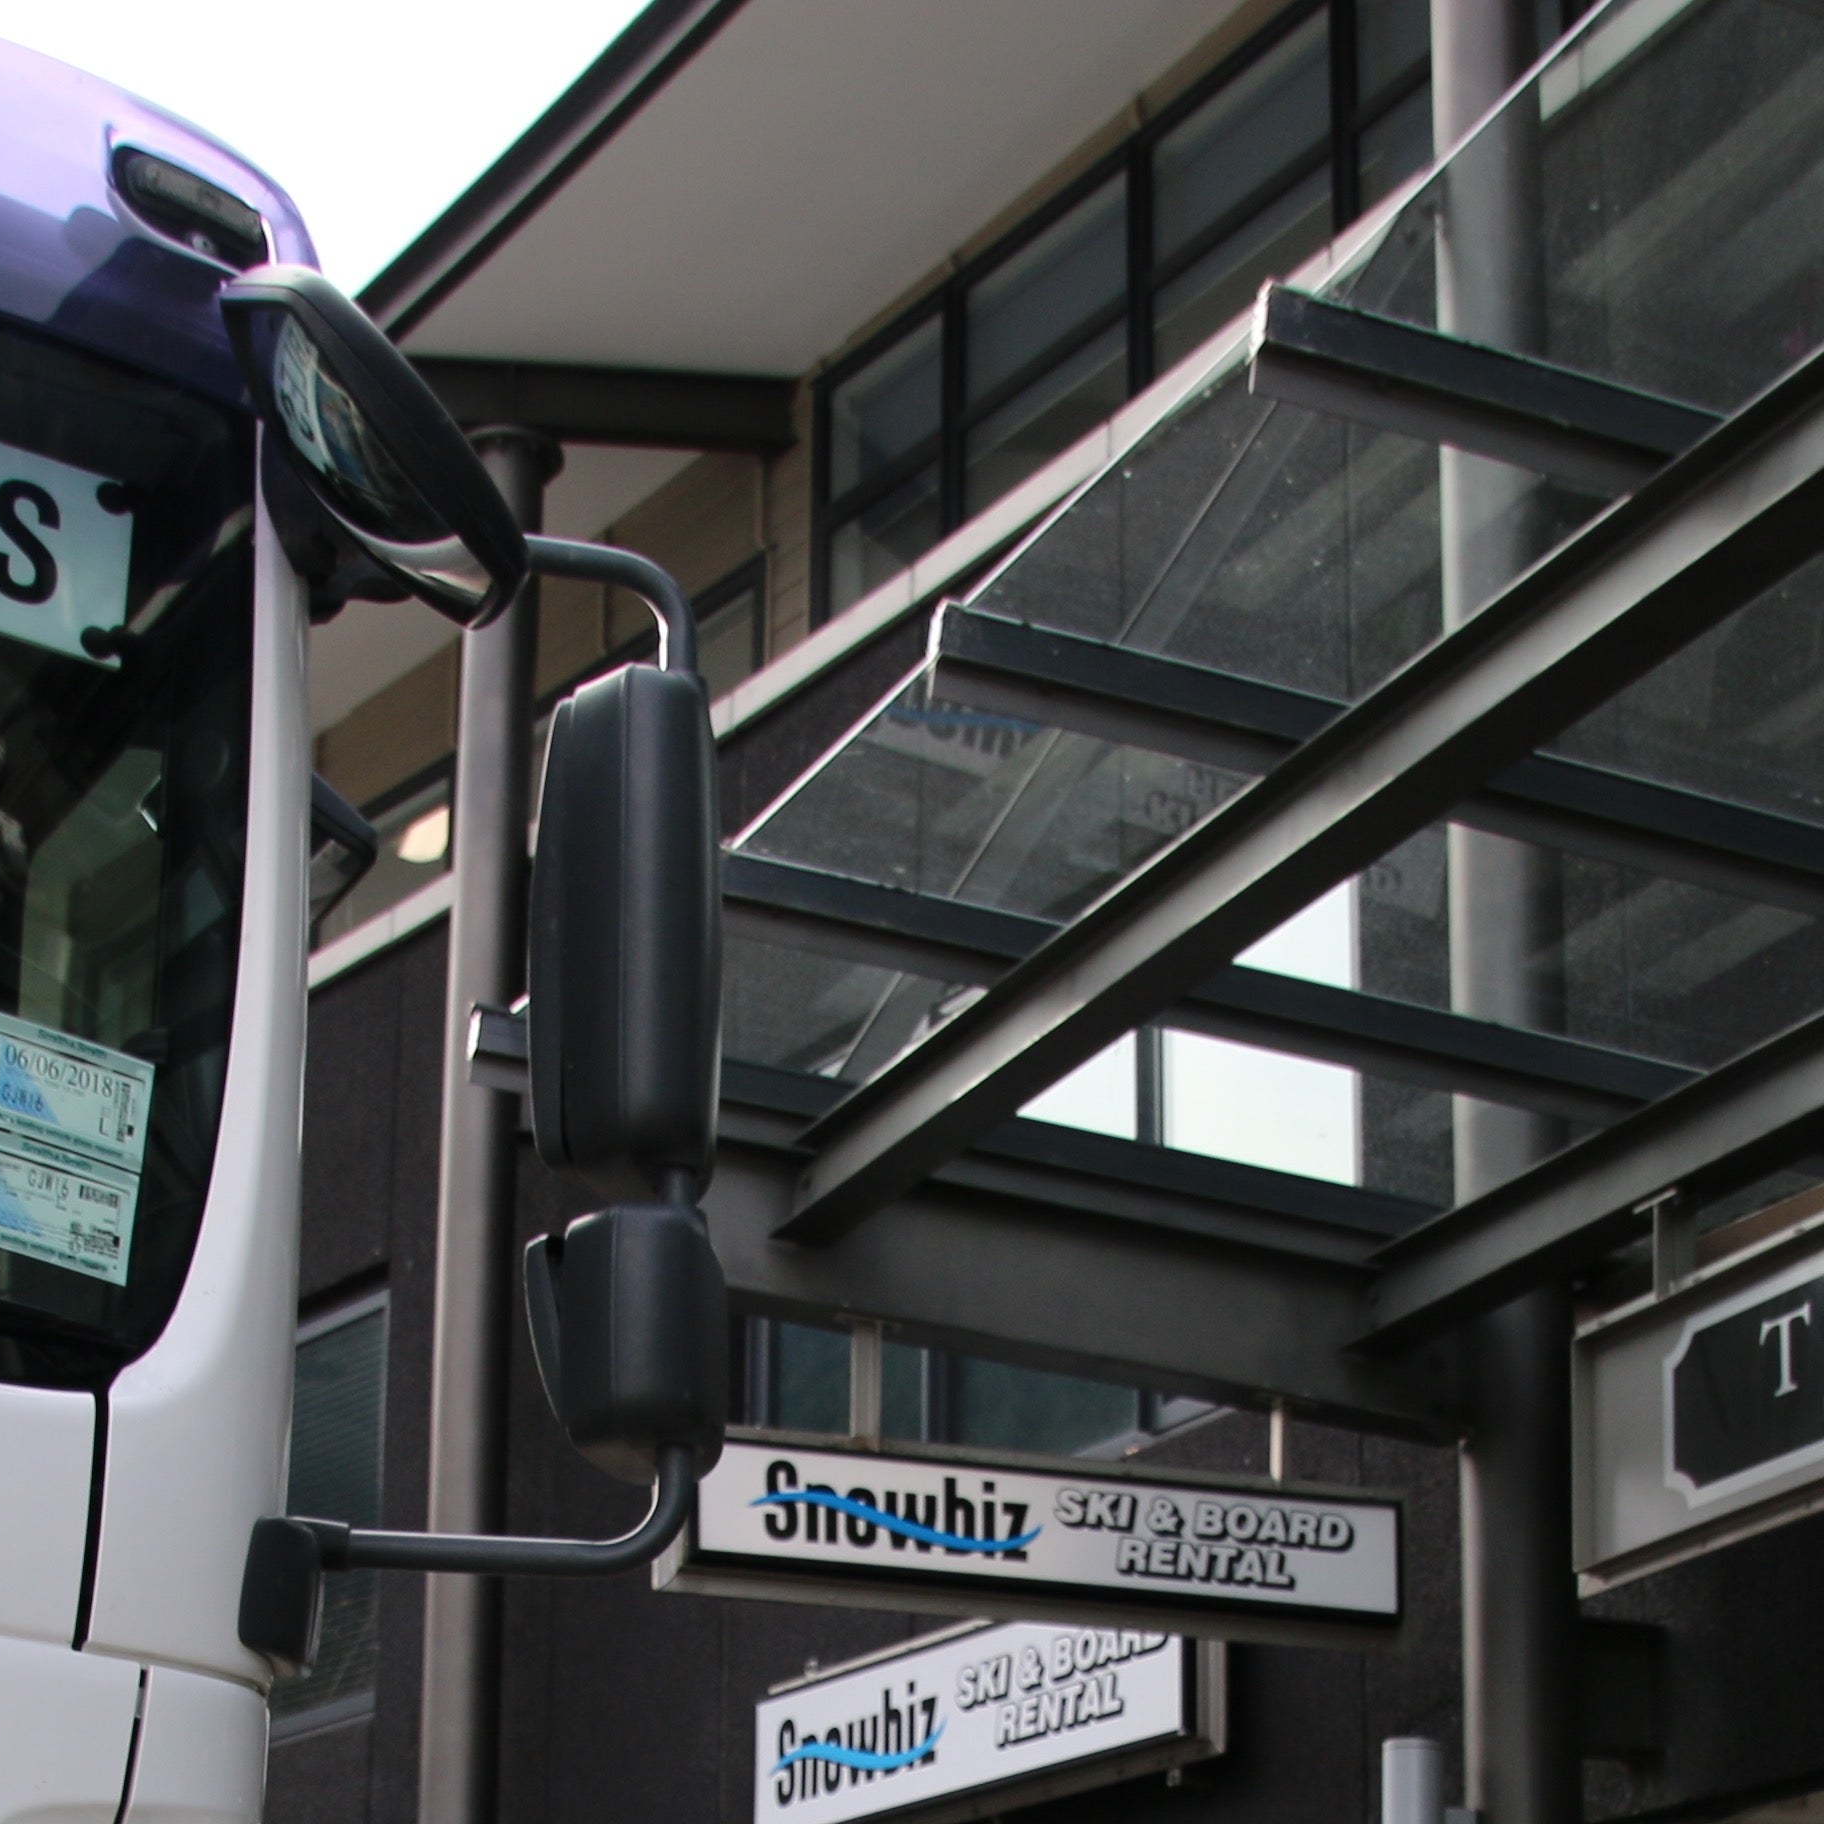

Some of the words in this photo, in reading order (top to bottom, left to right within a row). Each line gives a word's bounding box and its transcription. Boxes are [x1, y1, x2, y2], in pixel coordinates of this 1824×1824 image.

[3, 1042, 114, 1099] 06/06/2018
[760, 1459, 1033, 1563] Snowbiz
[1054, 1488, 1137, 1534] SKI
[1147, 1497, 1185, 1539] &
[1193, 1501, 1355, 1552] BOARD
[1116, 1538, 1296, 1591] RENTAL
[955, 1655, 1011, 1711] SKI
[1016, 1648, 1044, 1692] &
[995, 1671, 1124, 1749] RENTAL
[775, 1681, 941, 1807] Snowbiz
